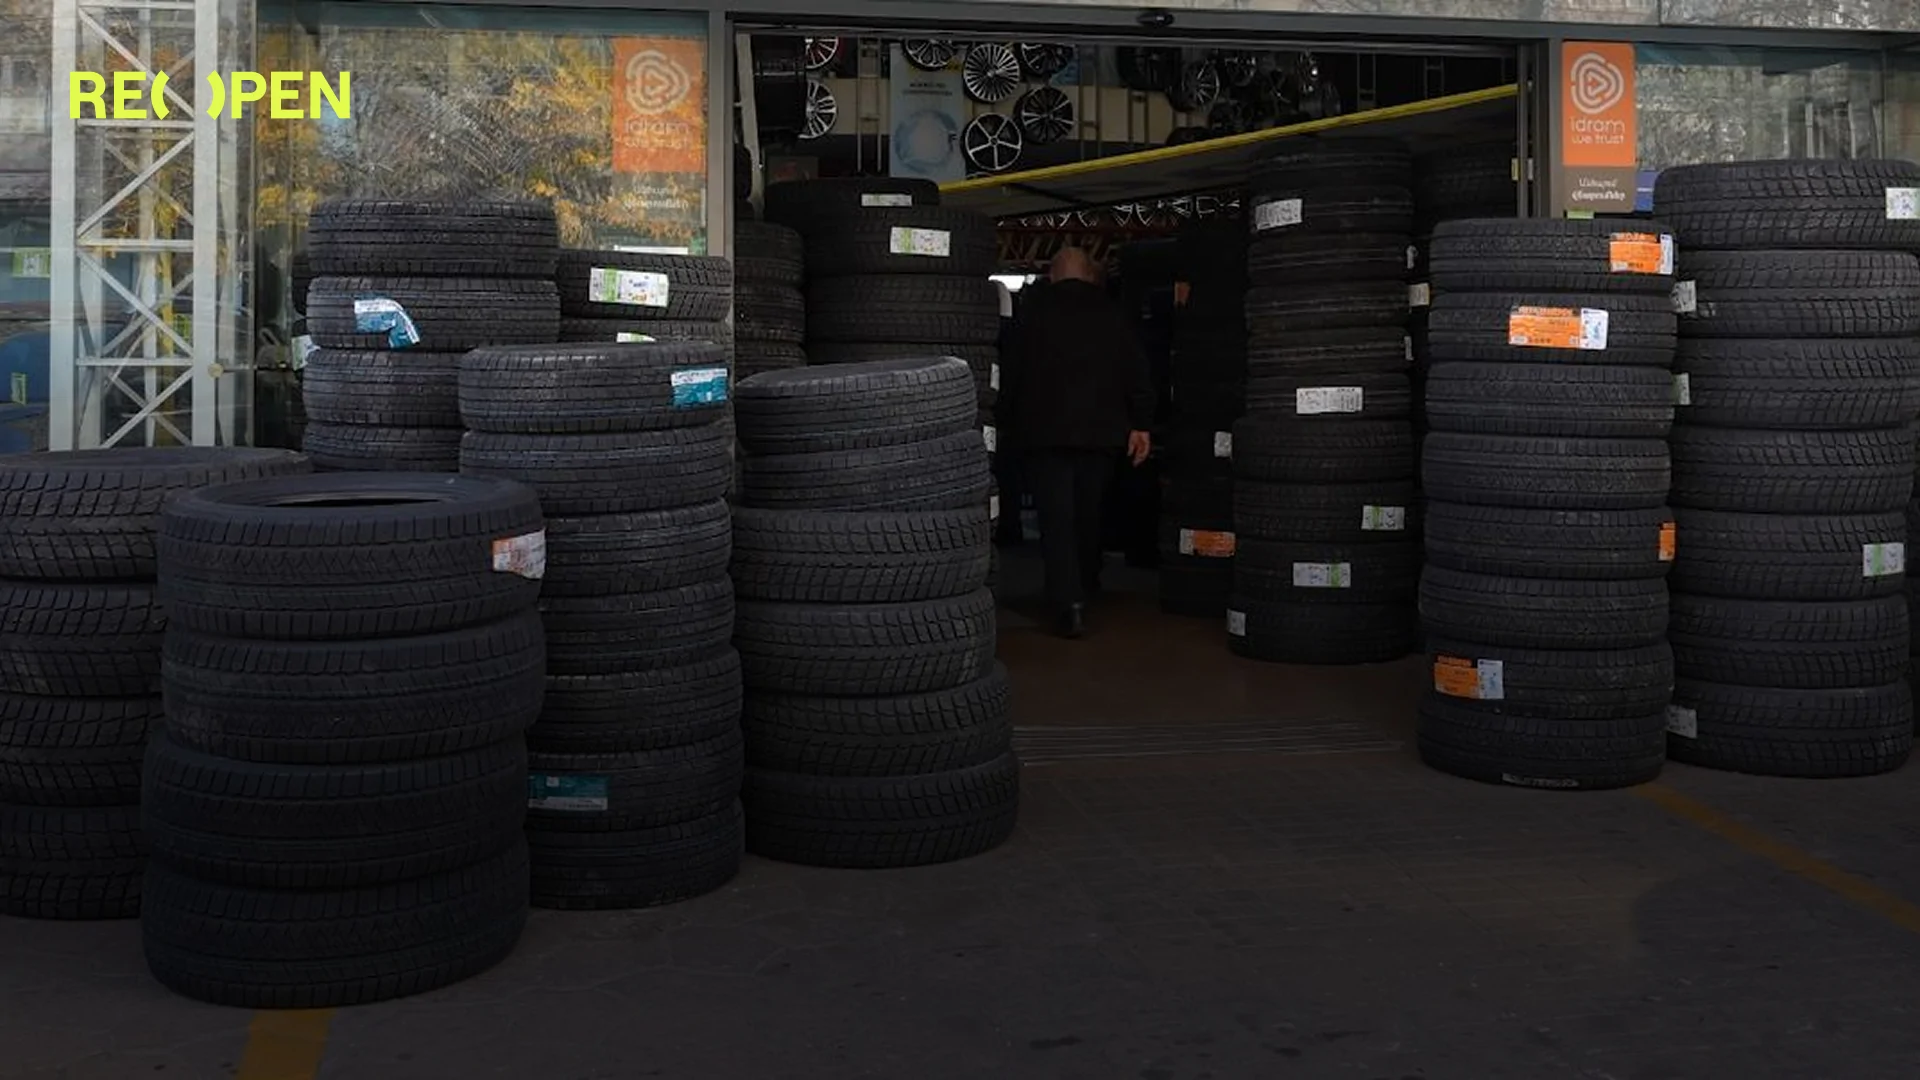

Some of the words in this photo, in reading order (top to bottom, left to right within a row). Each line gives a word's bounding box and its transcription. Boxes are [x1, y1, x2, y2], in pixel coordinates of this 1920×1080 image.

[1570, 116, 1626, 133] idram
[1571, 135, 1593, 144] we
[1595, 134, 1625, 144] trust
